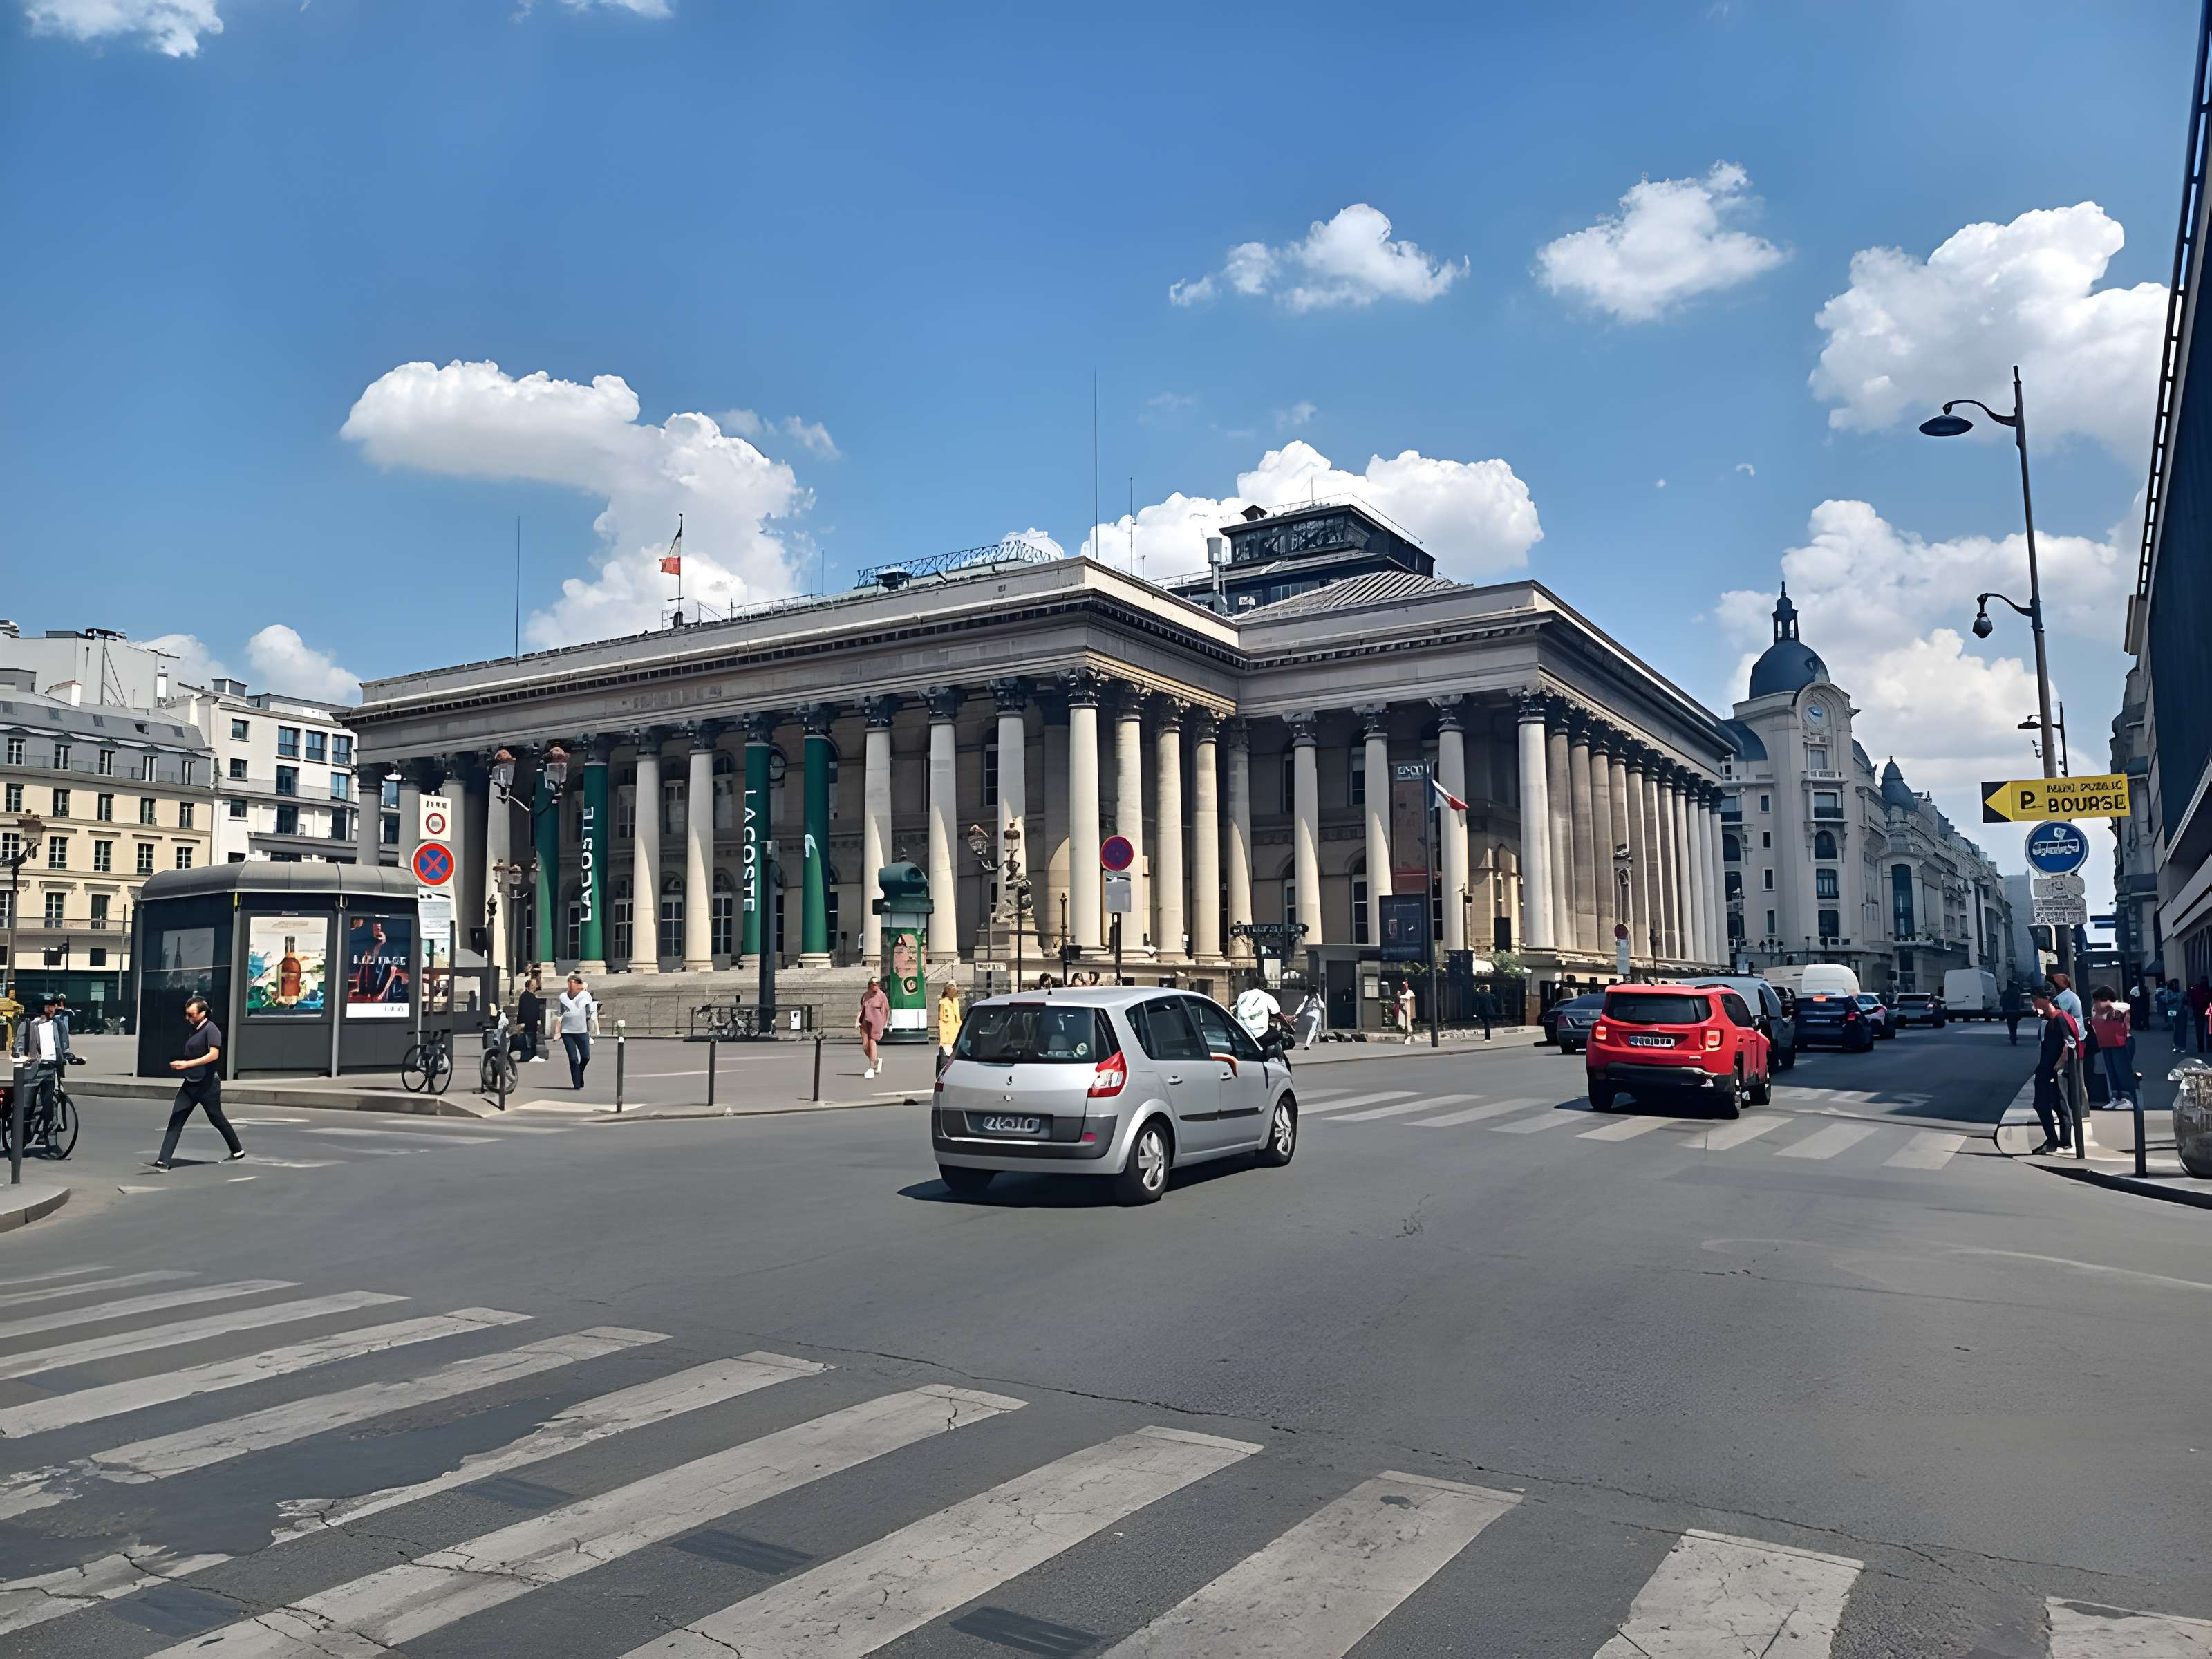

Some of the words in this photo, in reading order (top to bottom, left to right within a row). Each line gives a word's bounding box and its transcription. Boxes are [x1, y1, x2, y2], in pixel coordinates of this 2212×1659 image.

[2021, 791, 2035, 810] P
[2048, 794, 2126, 813] BOURSE
[580, 806, 594, 921] LACOSTE
[743, 790, 756, 912] LACOSTE
